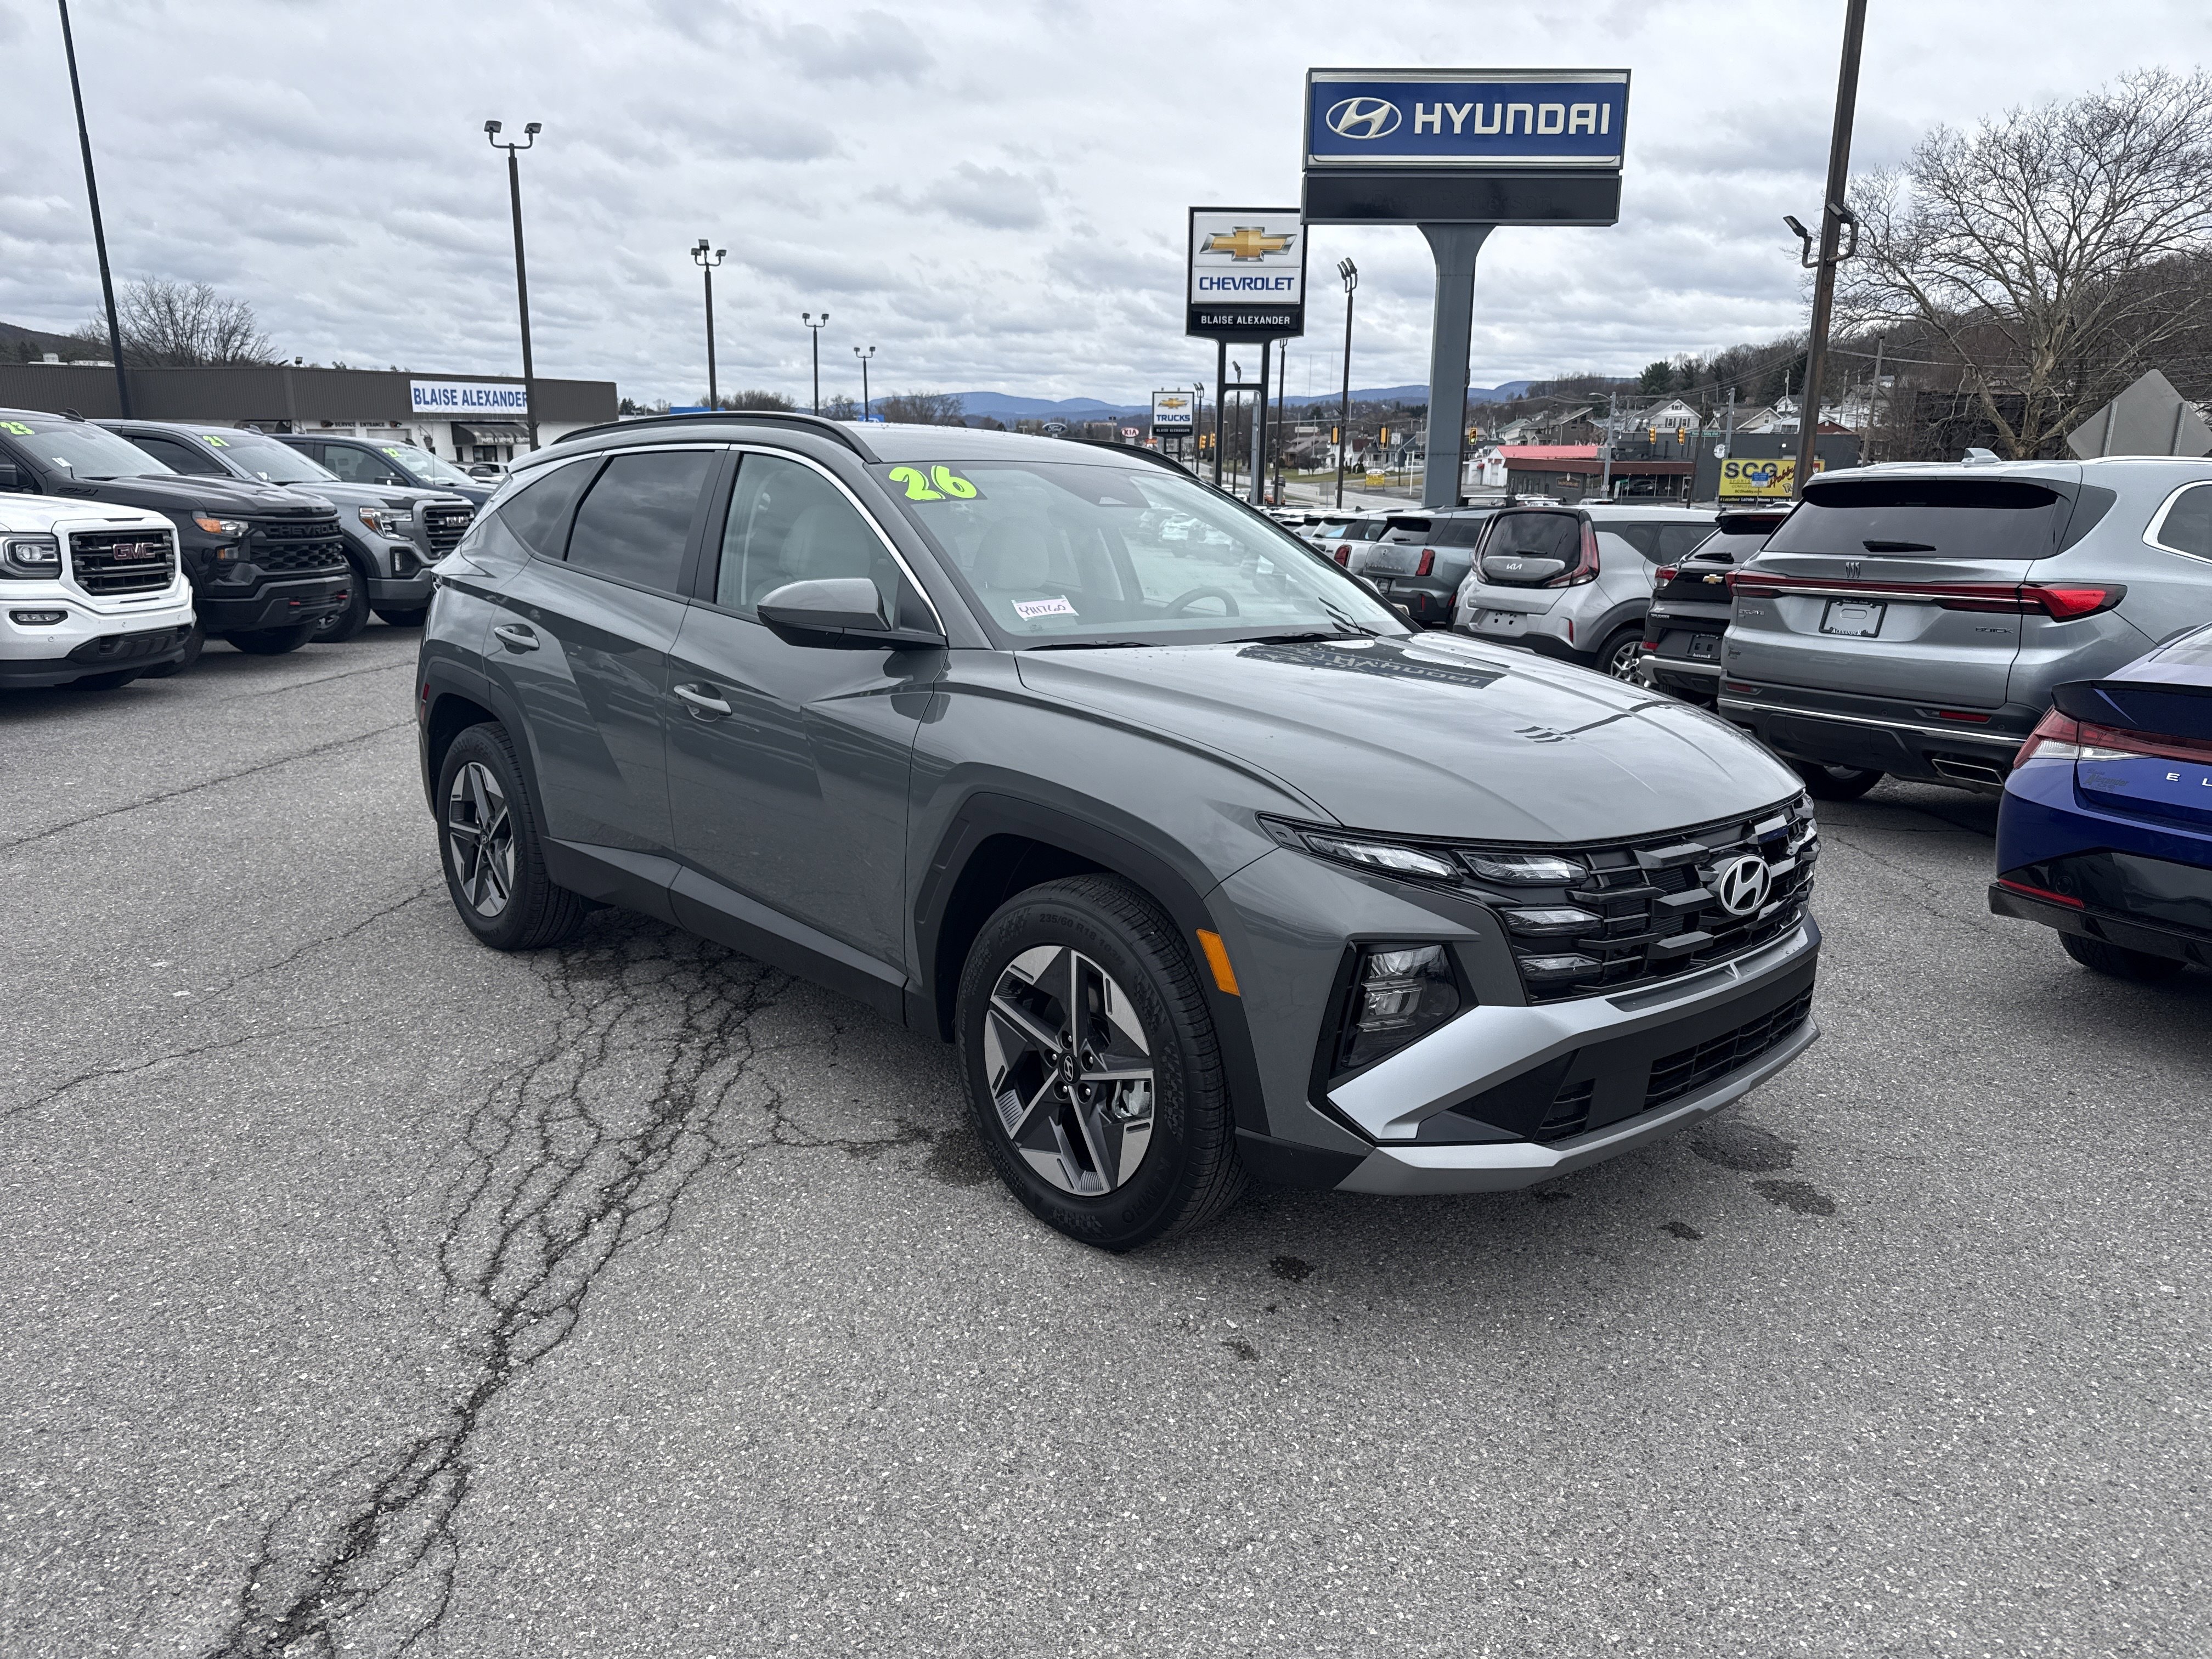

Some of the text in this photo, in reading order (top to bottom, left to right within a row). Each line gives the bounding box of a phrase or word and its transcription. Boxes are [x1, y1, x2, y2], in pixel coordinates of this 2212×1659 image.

[1414, 103, 1610, 134] HYUNDAI
[1199, 276, 1295, 291] CHEVROLET
[1200, 315, 1290, 325] BLAISE ALEXANDER
[413, 388, 458, 405] BLAISE
[1724, 462, 1778, 479] SCG
[889, 465, 977, 500] 26
[267, 524, 338, 536] CHEVROLE
[113, 542, 155, 561] GMC
[1040, 913, 1074, 928] 235/60
[1075, 923, 1097, 941] R18
